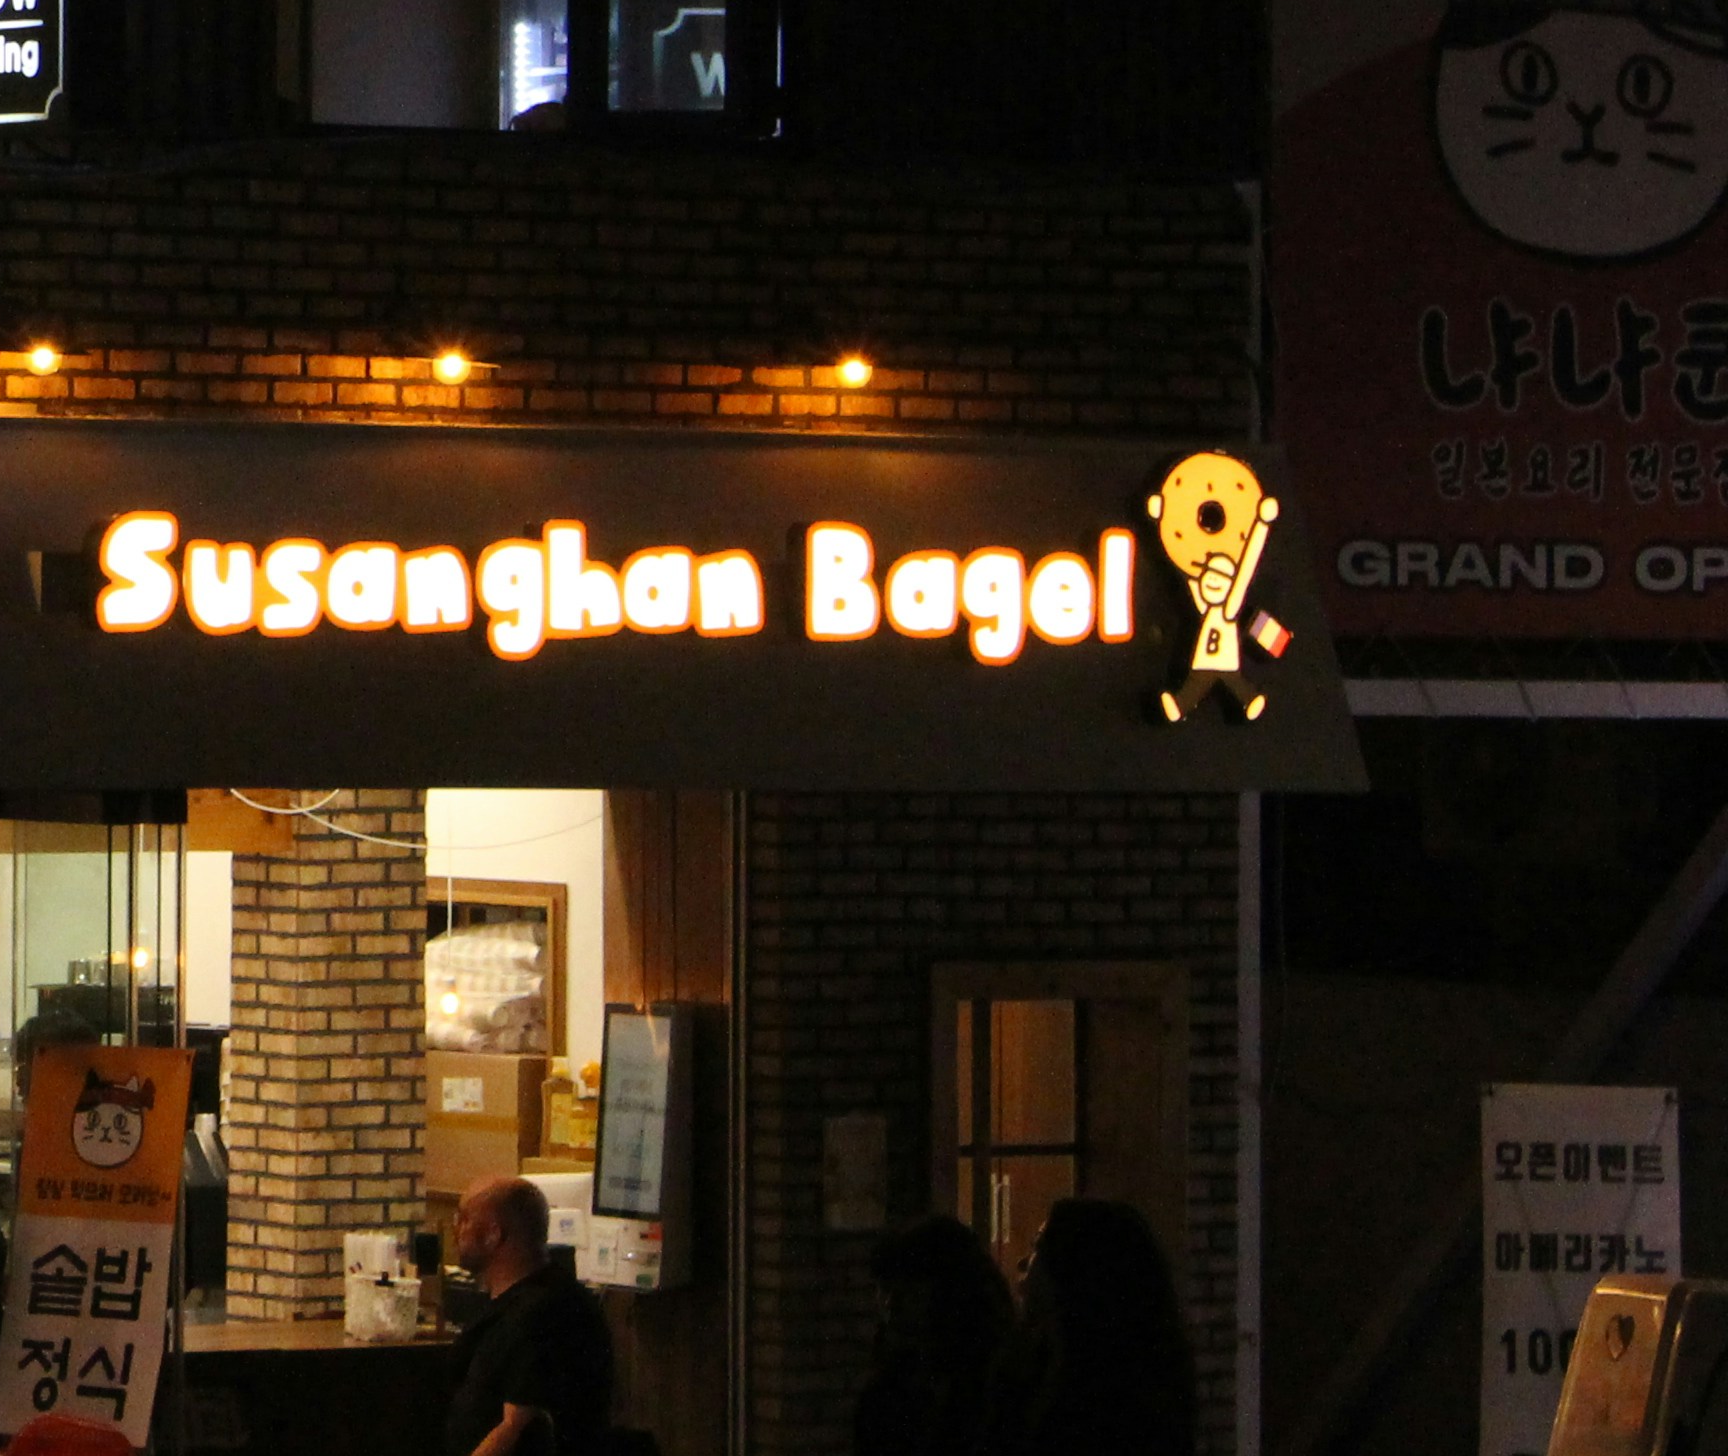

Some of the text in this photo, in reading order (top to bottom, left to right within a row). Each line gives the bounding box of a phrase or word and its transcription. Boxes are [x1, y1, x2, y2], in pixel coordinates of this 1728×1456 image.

[1418, 295, 1728, 423] 냐냐쿤
[1431, 436, 1604, 502] 일본요리
[96, 509, 1135, 665] Susanghan Bagel
[1337, 539, 1606, 591] GRAND
[1495, 1139, 1665, 1185] 오픈이벤트
[27, 1243, 153, 1321] 솥밥
[1495, 1232, 1666, 1274] 아메리카노
[18, 1336, 136, 1421] 정식
